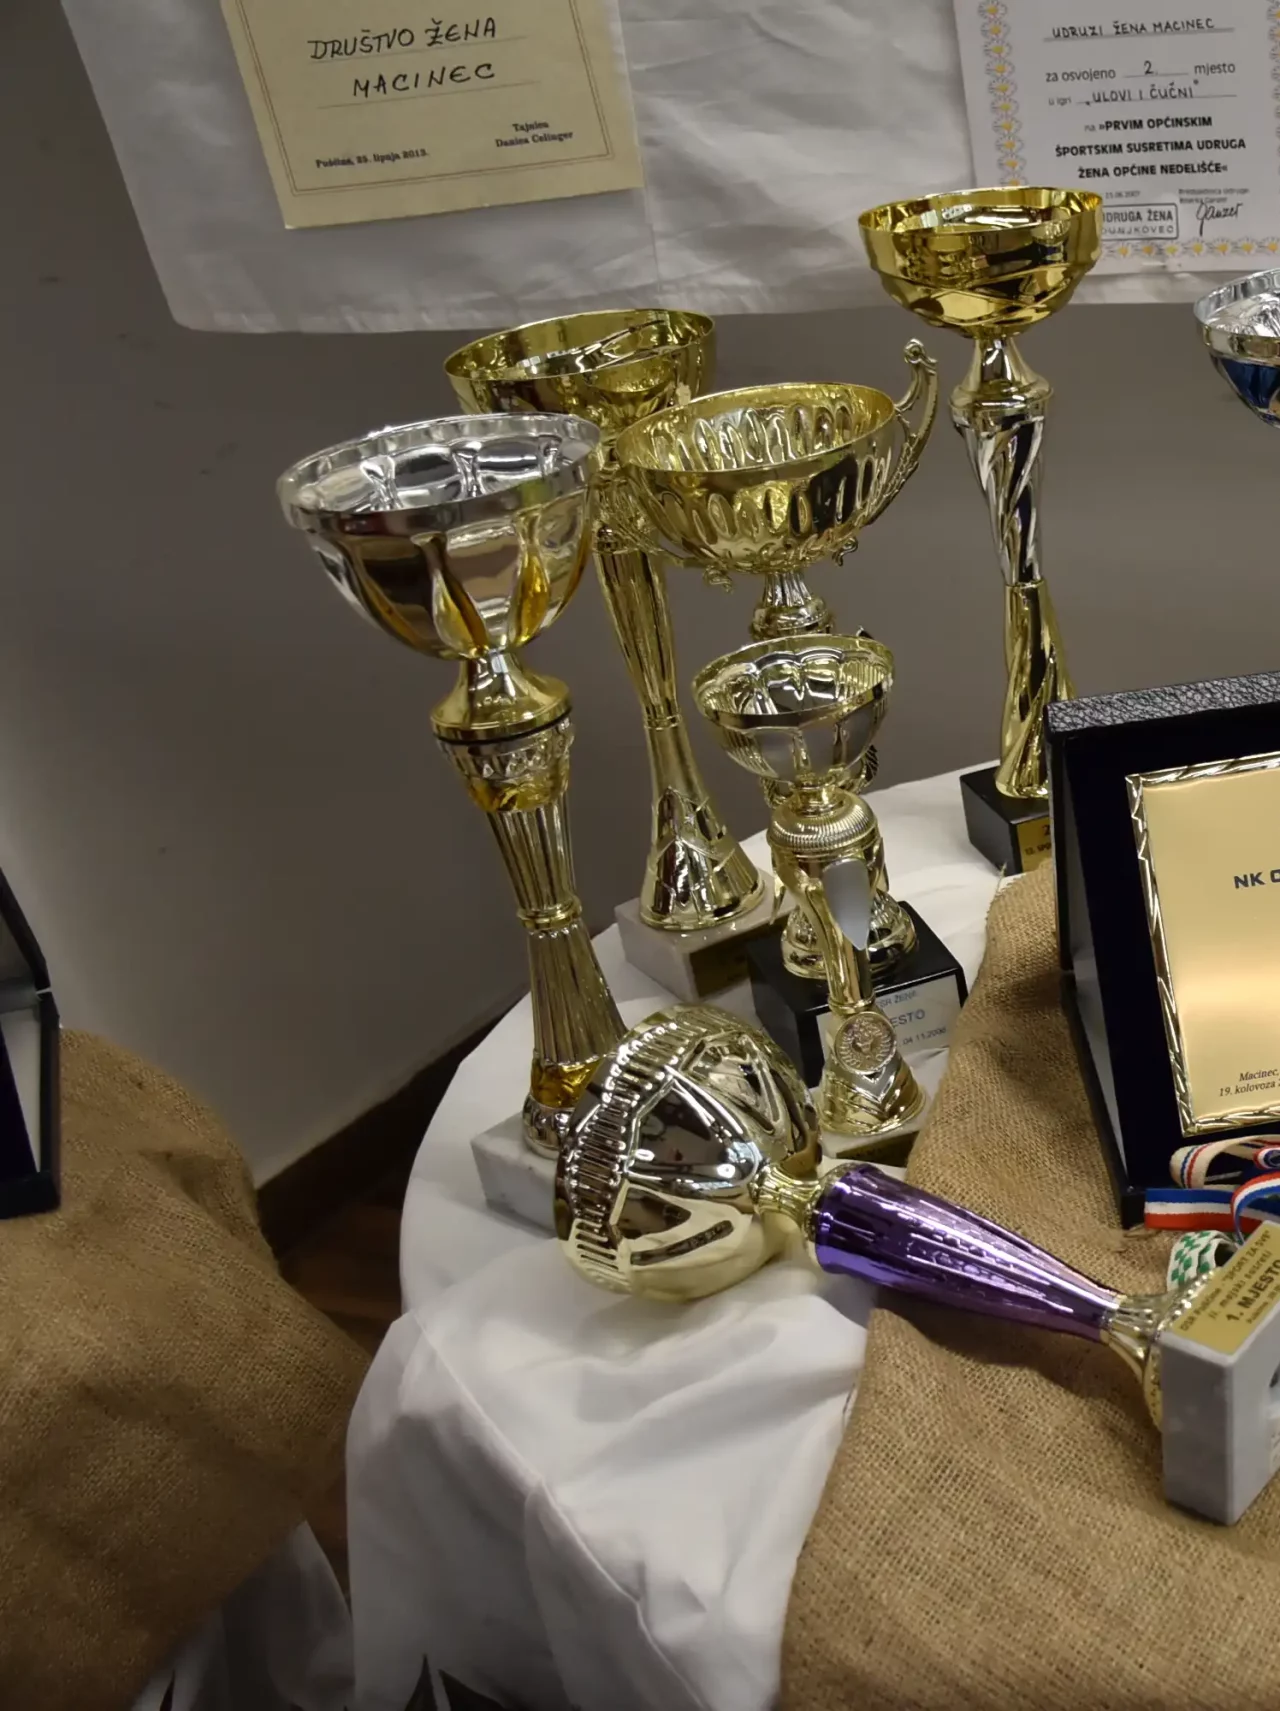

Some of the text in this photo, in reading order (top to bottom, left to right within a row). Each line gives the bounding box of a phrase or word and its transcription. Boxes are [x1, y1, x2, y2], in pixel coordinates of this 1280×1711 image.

[1052, 18, 1215, 39] UDRUZI ŽENA MACINEC
[307, 17, 496, 60] DRUŠTVO ŽENA
[1046, 69, 1116, 83] za osvojeno
[1194, 62, 1236, 77] mjesto
[353, 63, 495, 98] MACINEC
[1147, 116, 1213, 129] OPĆINSKIM
[1055, 138, 1246, 157] ŠPORTSKIM SUSRETIMA UDRUGA
[1078, 166, 1109, 179] ŽENA
[1113, 163, 1157, 176] OPĆINE
[1147, 208, 1174, 222] ŽENA
[1233, 871, 1266, 889] NK
[1219, 1087, 1233, 1097] 19.
[1234, 1080, 1276, 1095] kolovoza
[1226, 1311, 1245, 1321] 1.
